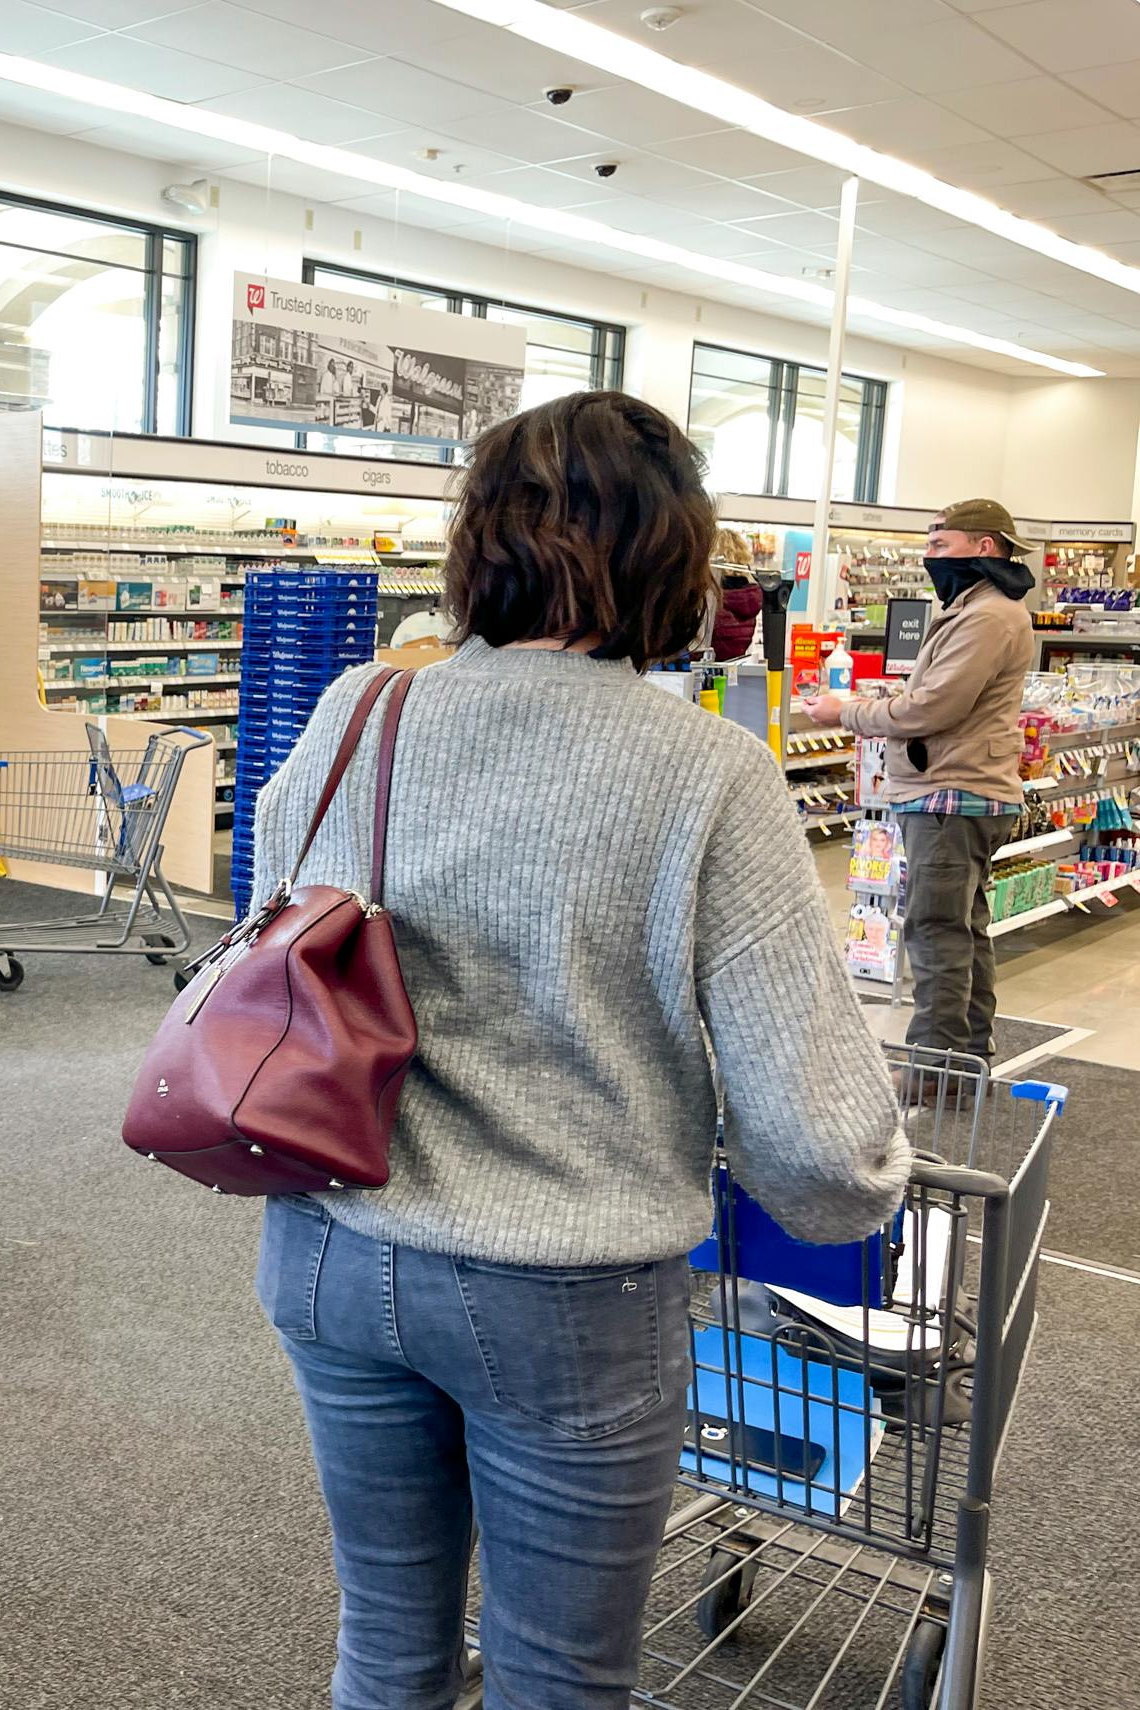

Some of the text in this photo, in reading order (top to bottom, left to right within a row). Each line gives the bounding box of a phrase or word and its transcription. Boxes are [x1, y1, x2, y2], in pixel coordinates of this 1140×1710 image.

[270, 291, 369, 325] Trusted since 1901
[266, 460, 391, 487] tobacco cigars
[1059, 527, 1096, 538] memory
[1098, 528, 1124, 538] cards
[902, 619, 919, 629] exit
[899, 631, 920, 640] here
